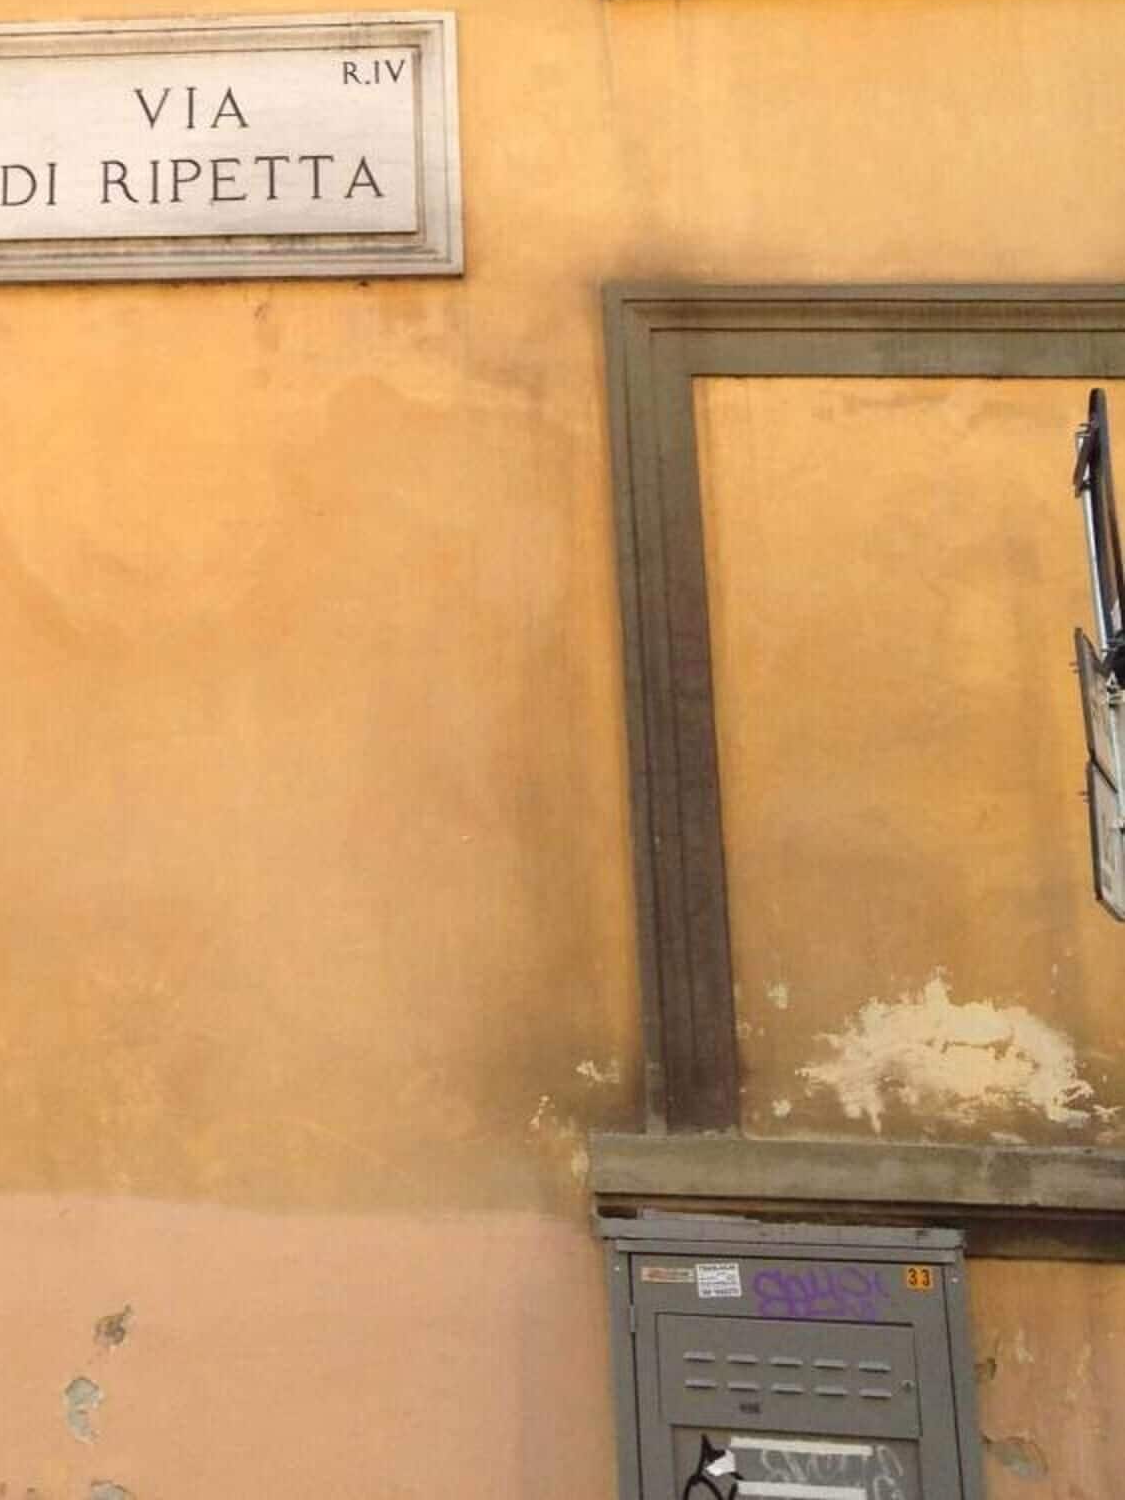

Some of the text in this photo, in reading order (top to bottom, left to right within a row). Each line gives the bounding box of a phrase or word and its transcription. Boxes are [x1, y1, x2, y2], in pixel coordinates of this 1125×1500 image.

[342, 59, 405, 85] R.IV
[134, 86, 250, 130] VIA
[0, 155, 385, 207] DI RIPETTA
[907, 1267, 931, 1287] 33
